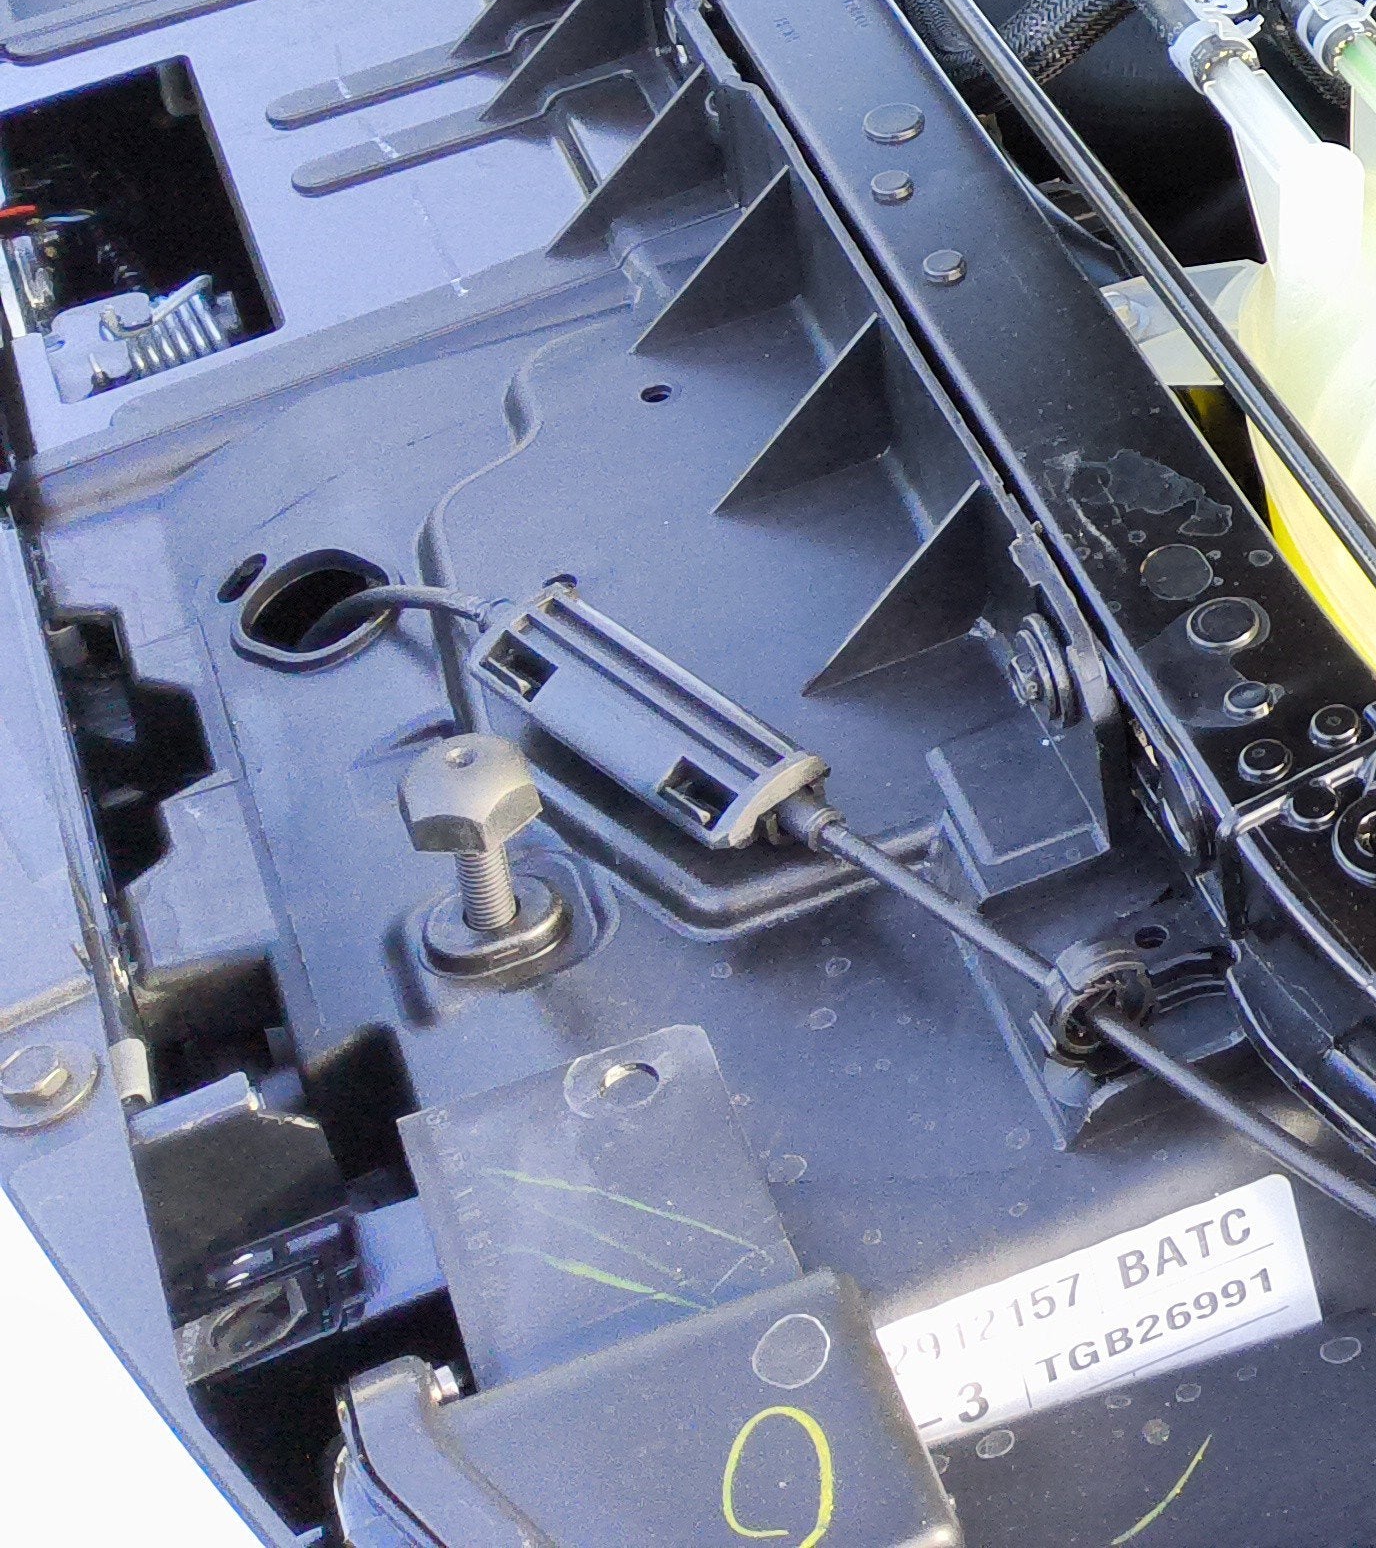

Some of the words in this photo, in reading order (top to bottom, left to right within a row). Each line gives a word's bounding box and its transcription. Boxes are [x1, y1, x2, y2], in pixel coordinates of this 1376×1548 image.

[1117, 1207, 1252, 1290] BATC
[957, 1382, 991, 1424] 3
[1034, 1267, 1275, 1383] TGB26991
